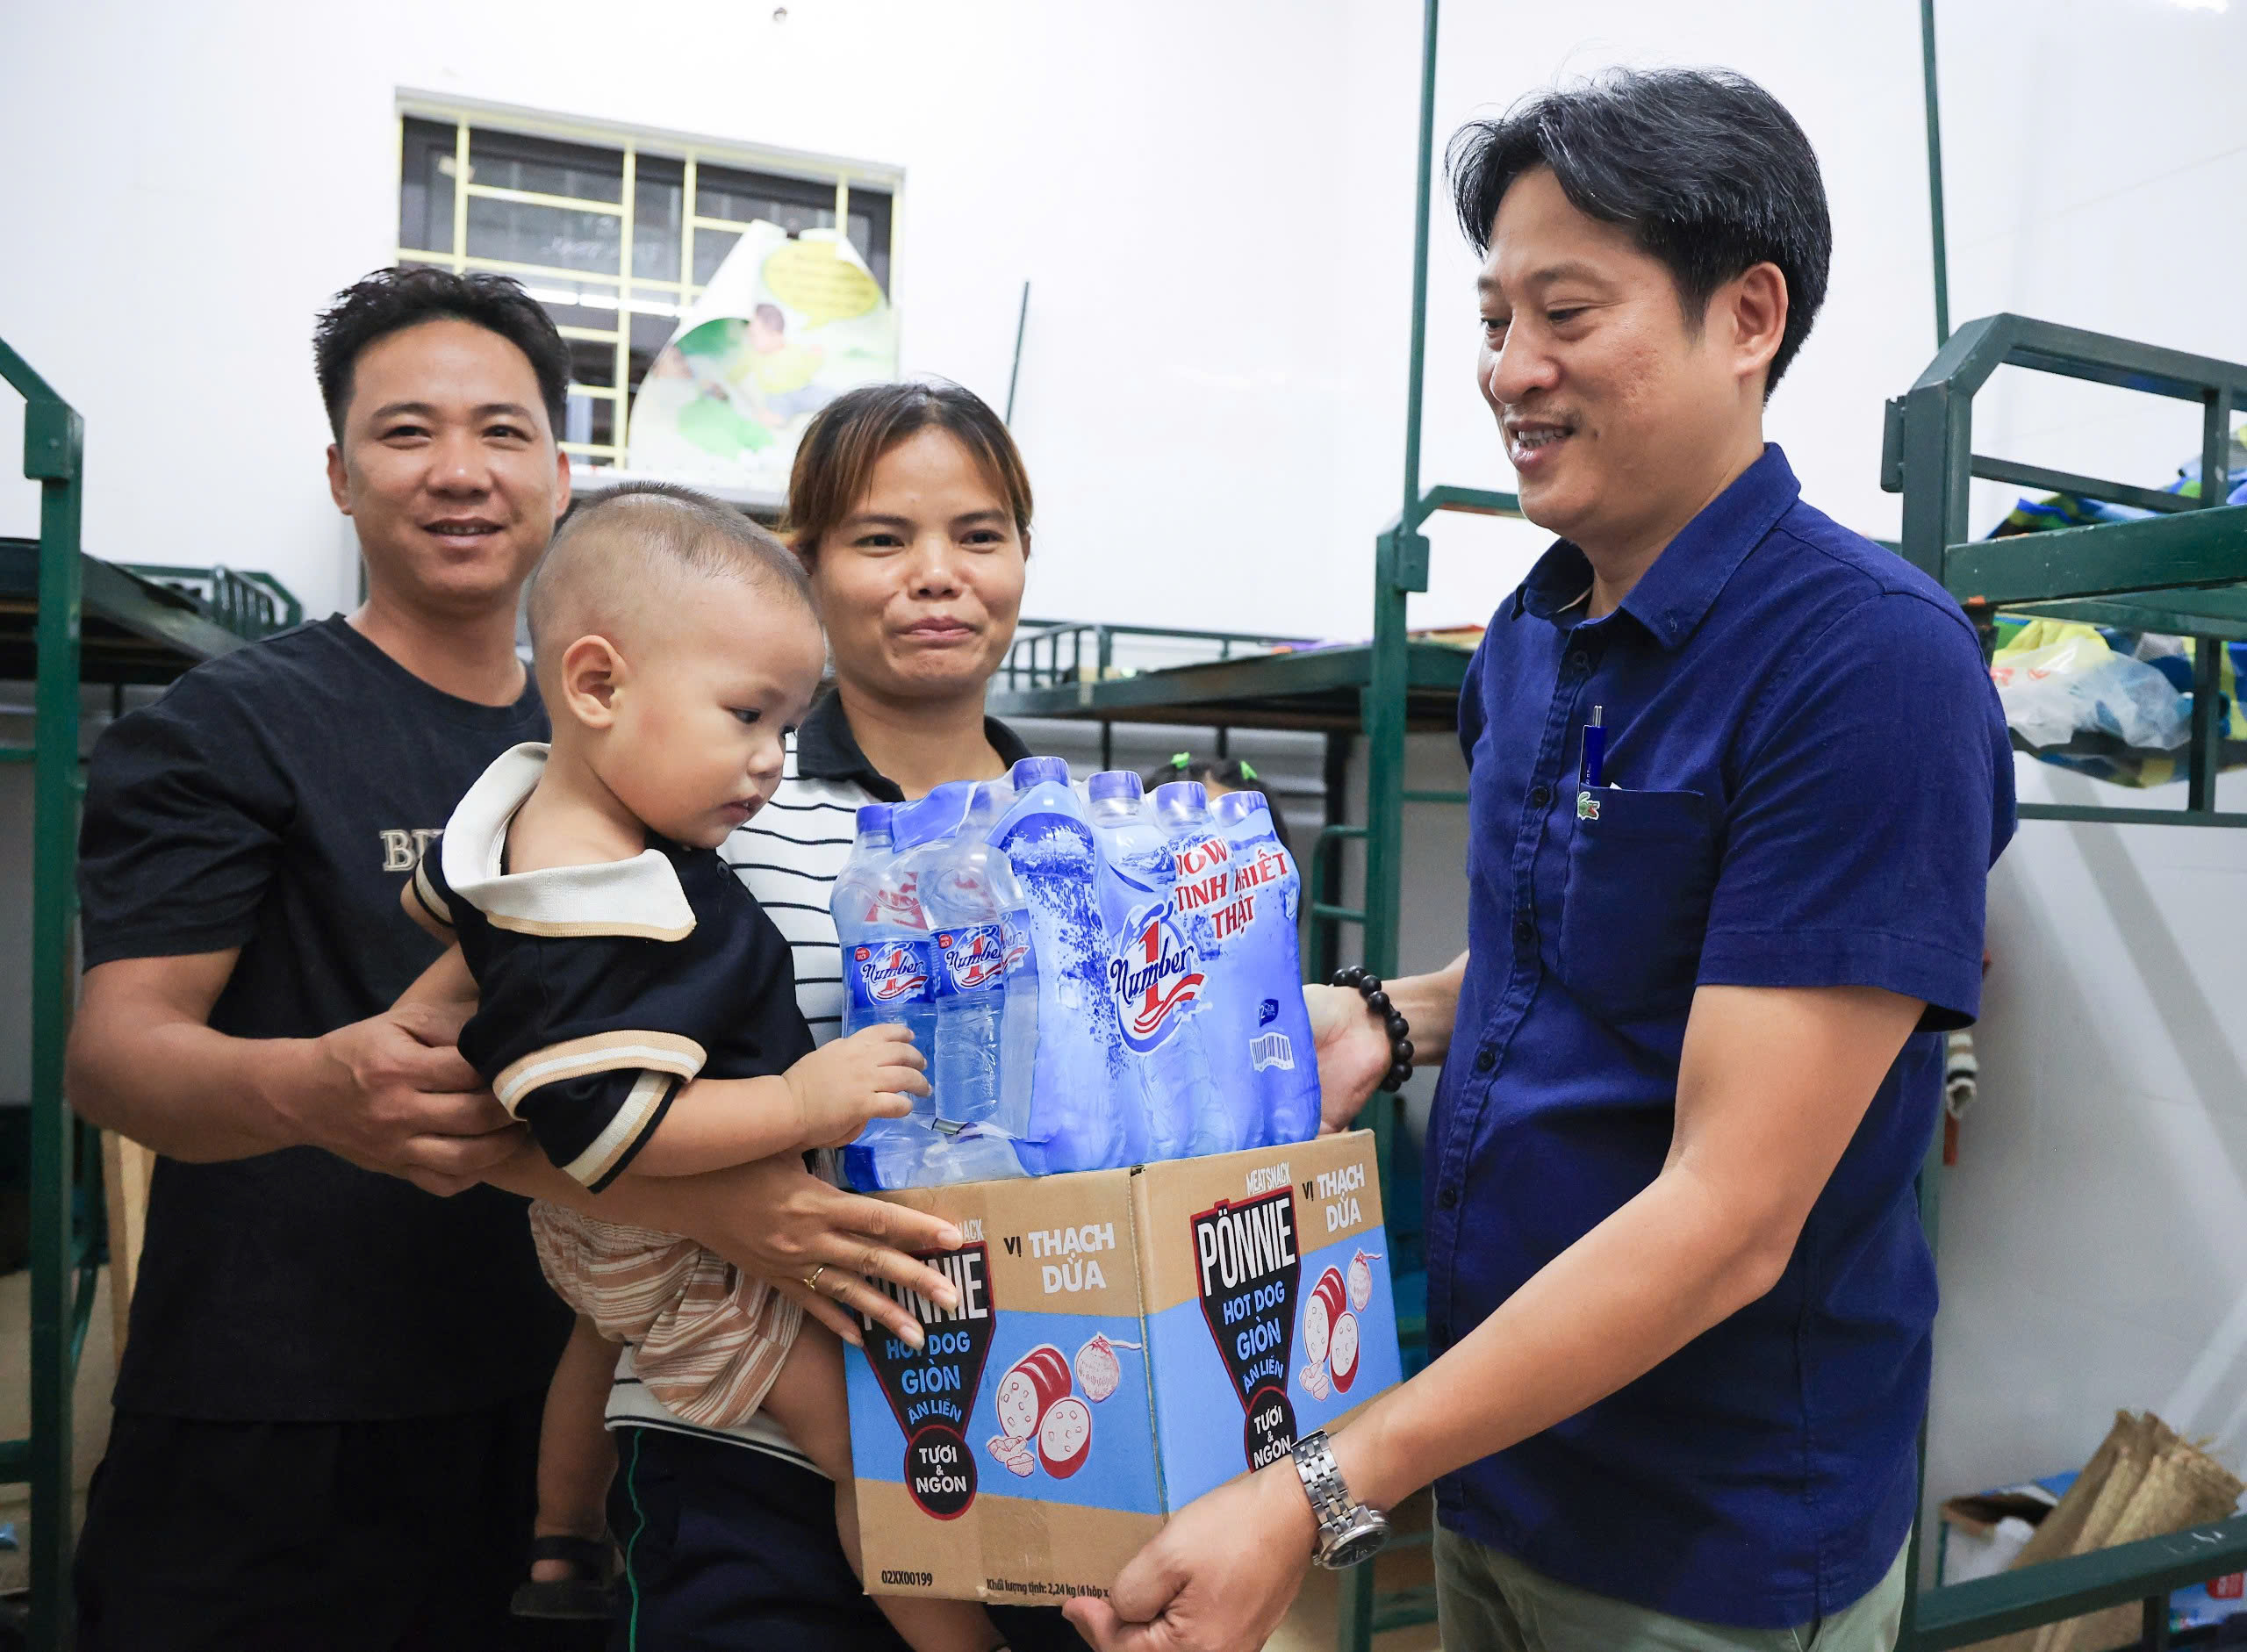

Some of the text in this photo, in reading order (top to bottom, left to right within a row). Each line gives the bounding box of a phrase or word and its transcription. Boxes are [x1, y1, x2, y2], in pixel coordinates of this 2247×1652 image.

[1175, 873, 1227, 912] TINH
[1211, 894, 1254, 939] THẬT
[863, 956, 923, 981] Number
[1110, 921, 1194, 1018] Number 1
[1302, 1163, 1366, 1202] VỊ THẠCH
[1325, 1192, 1362, 1233] DỪA
[1003, 1222, 1116, 1258] VỊ THẠCH
[1197, 1197, 1296, 1297] PÖNNIE
[1042, 1257, 1107, 1294] DỪA
[1223, 1280, 1285, 1325] HOT DOG
[928, 1331, 971, 1355] DOG
[1236, 1316, 1282, 1361] GIÒN
[901, 1358, 961, 1395] GIÒN
[919, 1444, 958, 1464] TƯƠI
[1253, 1434, 1291, 1469] NGON
[1267, 1430, 1274, 1442] &
[915, 1475, 967, 1493] NGON
[936, 1464, 944, 1476] &
[881, 1569, 933, 1587] 02XX00199
[1048, 1583, 1065, 1596] 2,24
[1066, 1584, 1076, 1598] kg
